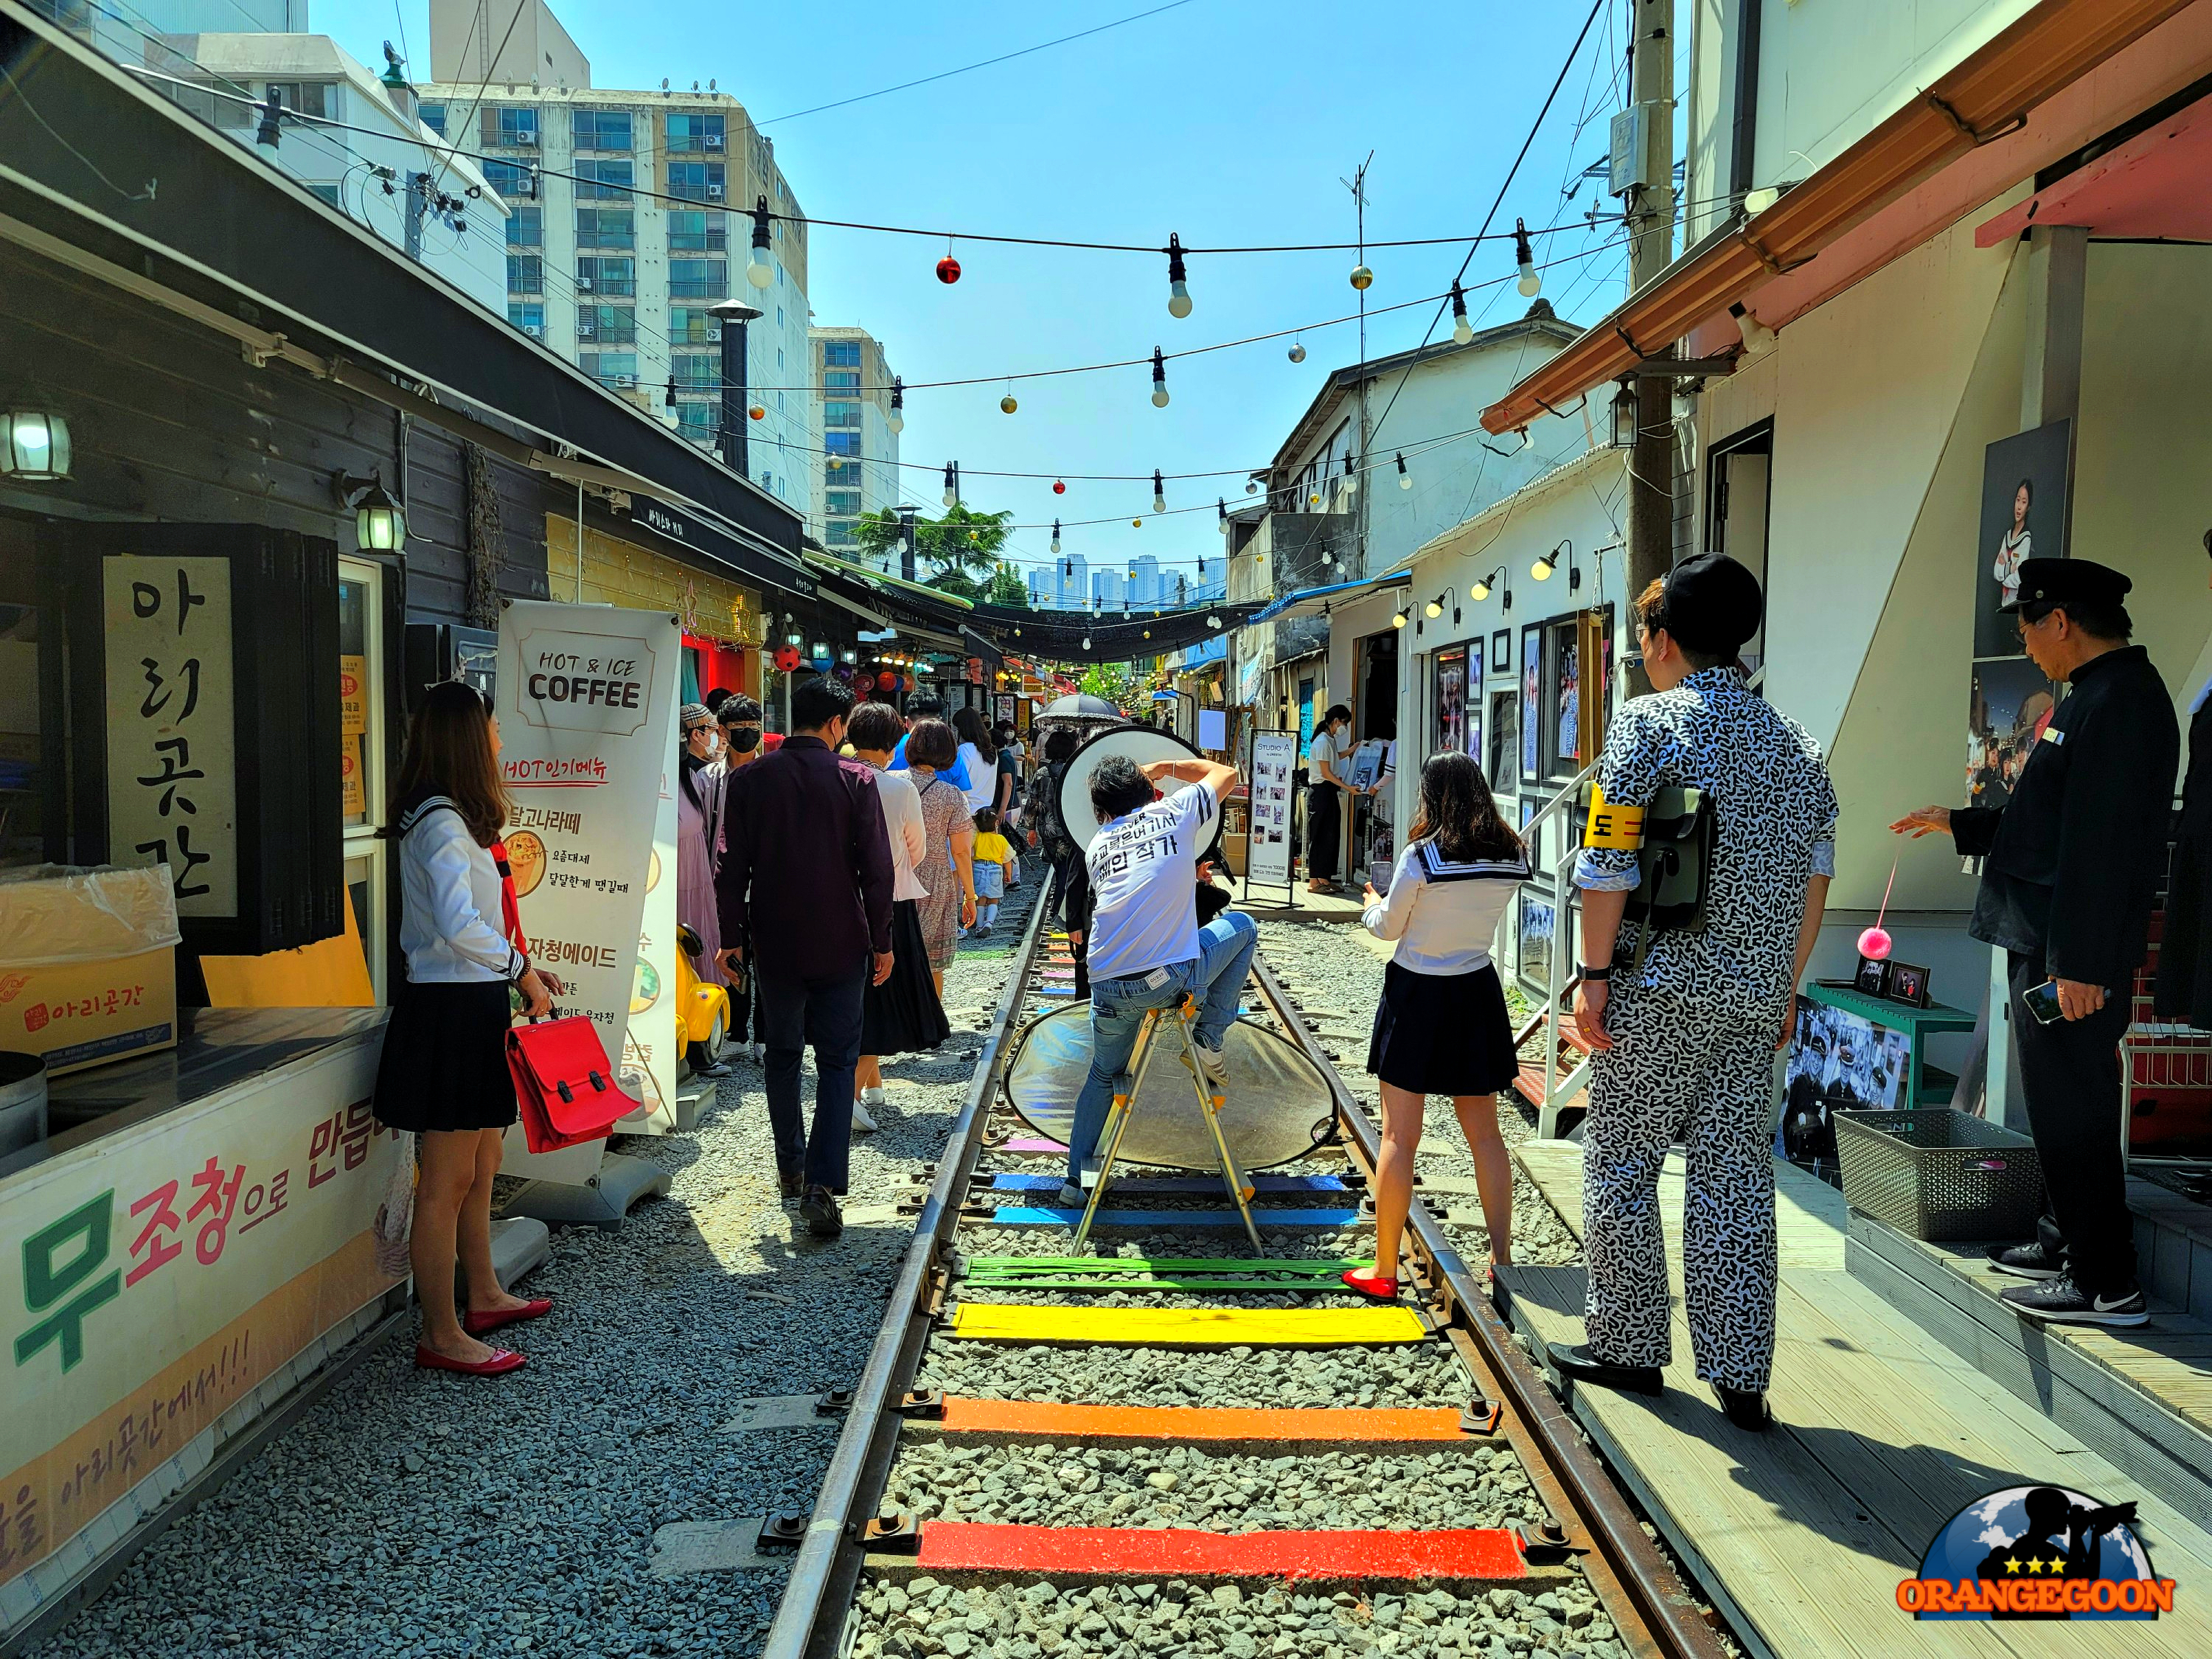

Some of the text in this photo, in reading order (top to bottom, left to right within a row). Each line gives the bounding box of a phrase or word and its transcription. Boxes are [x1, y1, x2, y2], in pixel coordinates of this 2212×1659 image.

[539, 652, 637, 677] HOT & ICE
[528, 673, 641, 709] COFFEE
[341, 702, 360, 712] 제과
[132, 568, 211, 900] 아리곳간
[1257, 743, 1290, 751] STUDIO A
[509, 806, 582, 835] 달고나라떼
[1110, 812, 1147, 835] NAVER
[1593, 814, 1613, 837] 도
[552, 849, 591, 865] 요즘대세
[1135, 835, 1178, 859] 작가
[549, 872, 629, 894] 달달한게 땡길때
[515, 937, 616, 968] 자청에이드
[1150, 972, 1164, 983] GUESS
[52, 984, 145, 1019] 아리곳간
